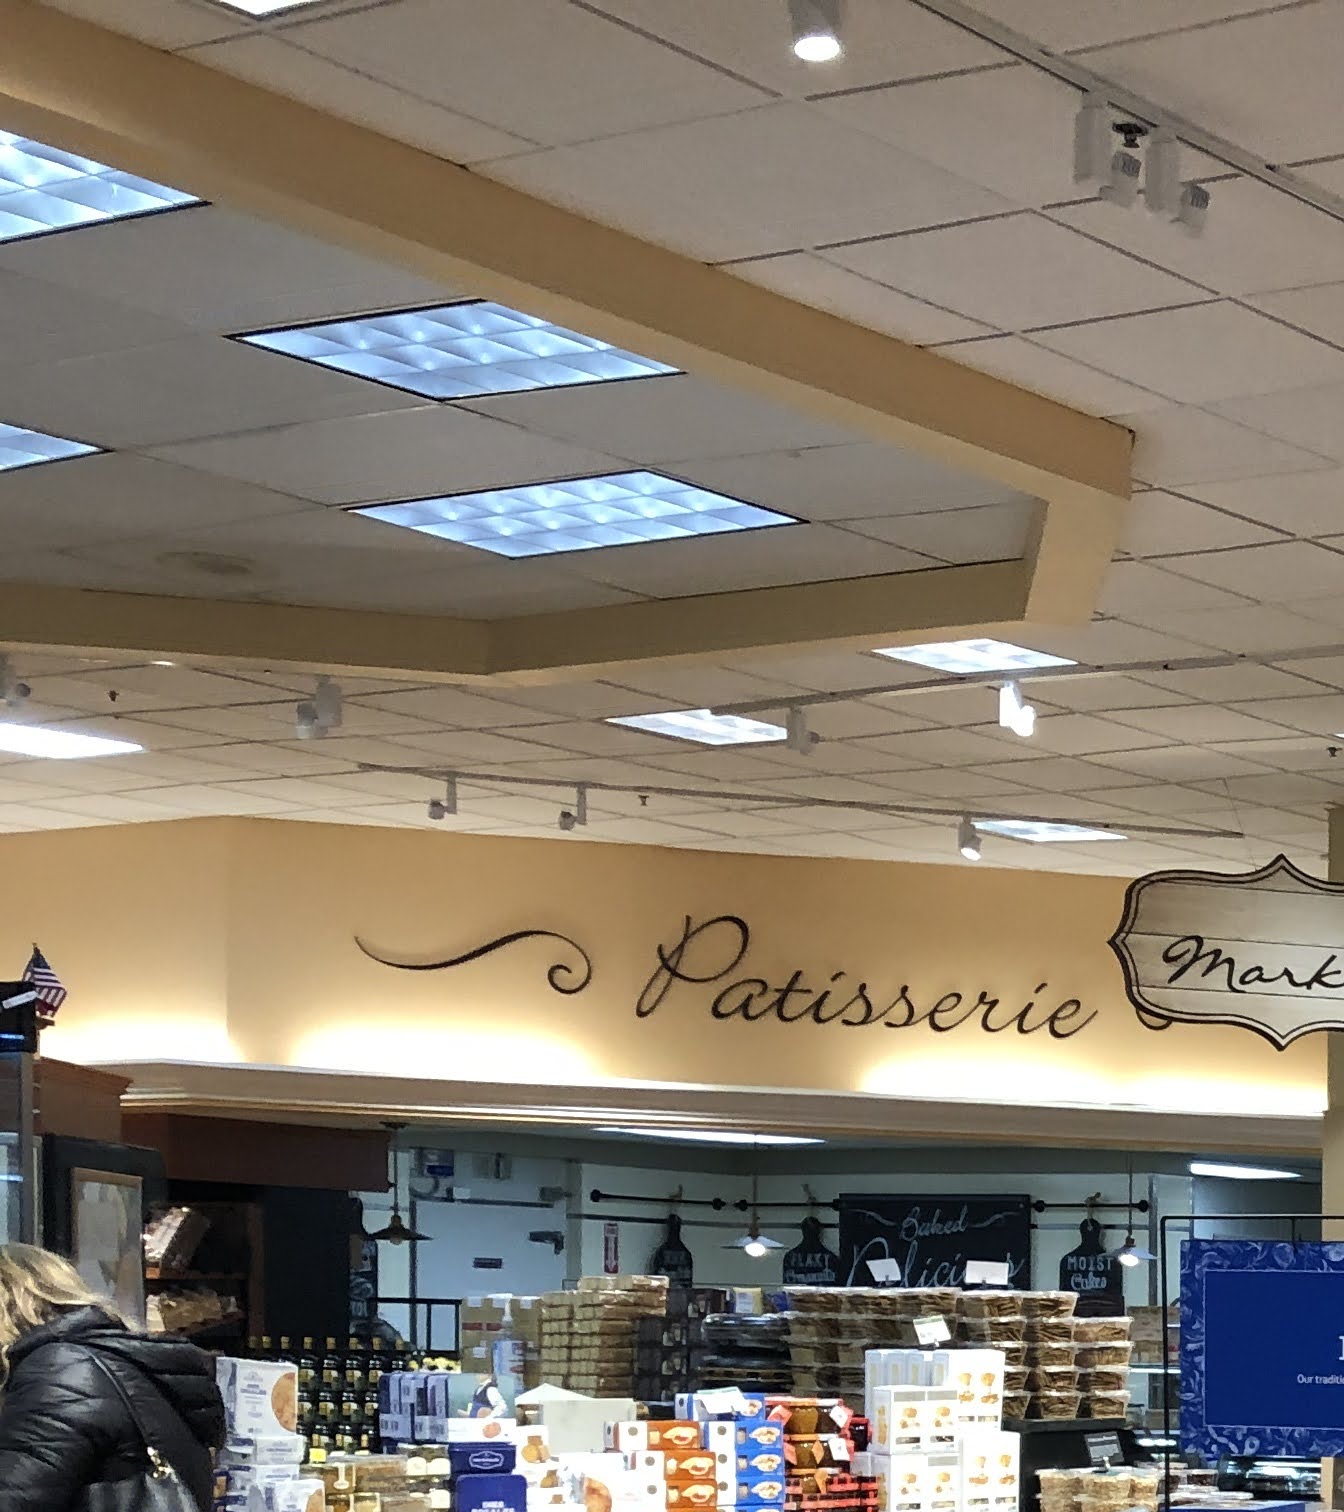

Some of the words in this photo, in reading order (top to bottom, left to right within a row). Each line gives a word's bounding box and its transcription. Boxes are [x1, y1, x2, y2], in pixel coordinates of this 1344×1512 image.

[635, 914, 1098, 1039] Patisserie
[1067, 1256, 1114, 1271] MOIST
[1297, 1374, 1313, 1385] Our
